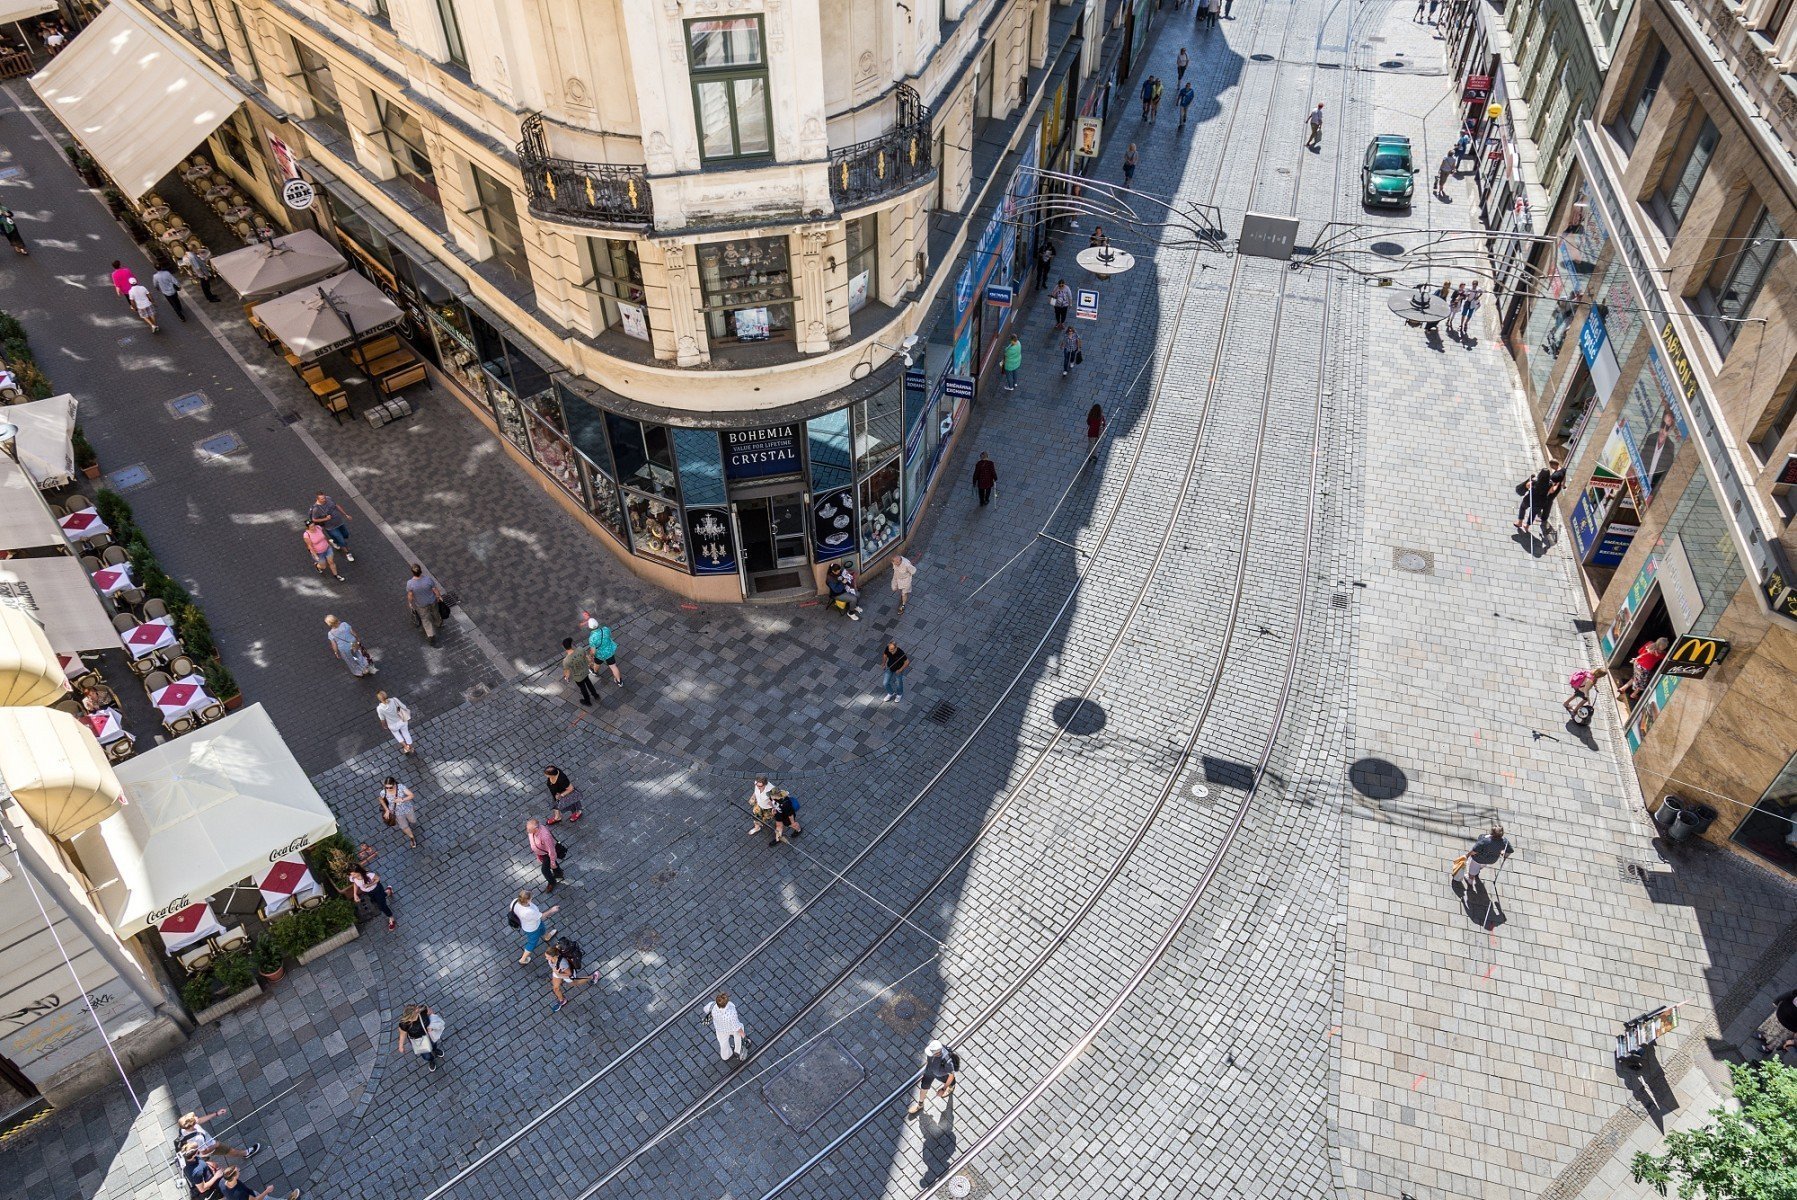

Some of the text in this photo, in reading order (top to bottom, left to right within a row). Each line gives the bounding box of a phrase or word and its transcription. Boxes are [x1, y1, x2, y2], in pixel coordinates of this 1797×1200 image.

[1661, 322, 1692, 386] BABYLON
[945, 387, 973, 396] EXCHANGE
[729, 426, 793, 443] BOHEMIA
[733, 444, 752, 452] VALUE
[764, 439, 792, 449] LIFETIME
[732, 448, 795, 466] CRYSTAL
[268, 832, 310, 863] Coca-Cola
[146, 893, 191, 925] Coca-Cola
